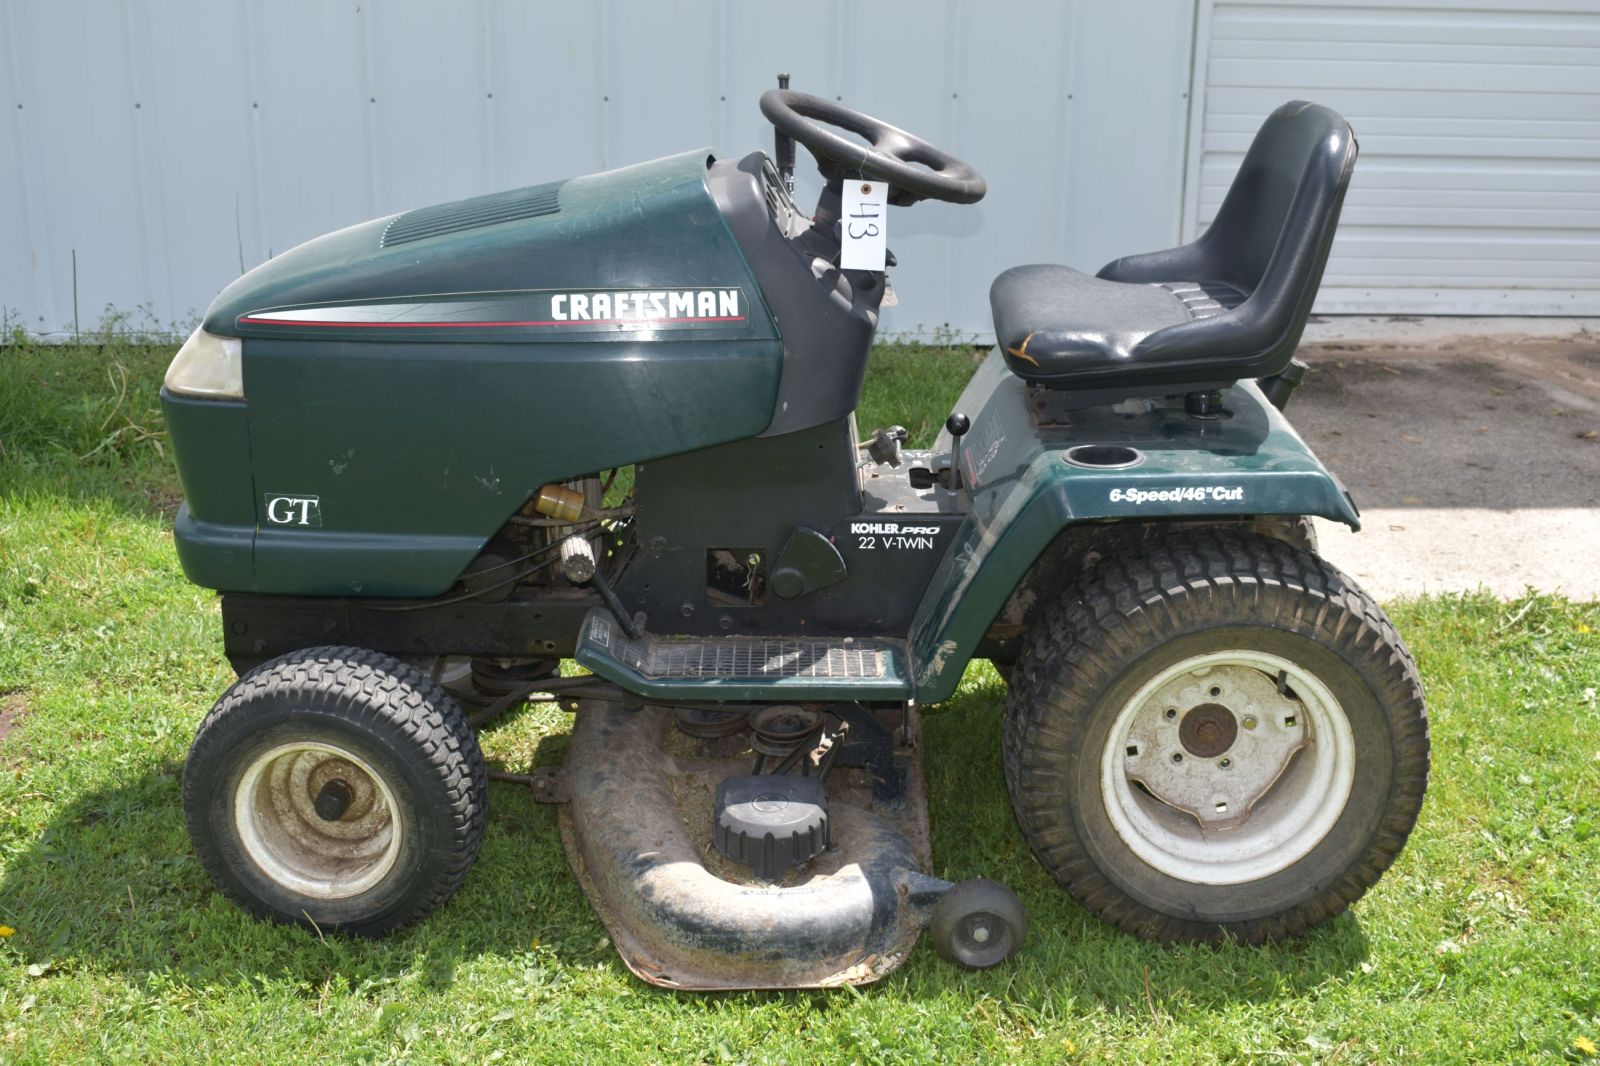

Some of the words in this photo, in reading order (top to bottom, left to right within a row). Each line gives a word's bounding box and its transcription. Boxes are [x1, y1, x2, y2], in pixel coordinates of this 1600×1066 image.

[848, 203, 881, 240] 43
[551, 290, 738, 320] CRAFTSMAN
[268, 497, 319, 525] GT
[851, 523, 899, 534] KOHLER
[900, 526, 941, 535] PRO
[858, 536, 876, 549] 22
[882, 536, 934, 549] V-TWIN
